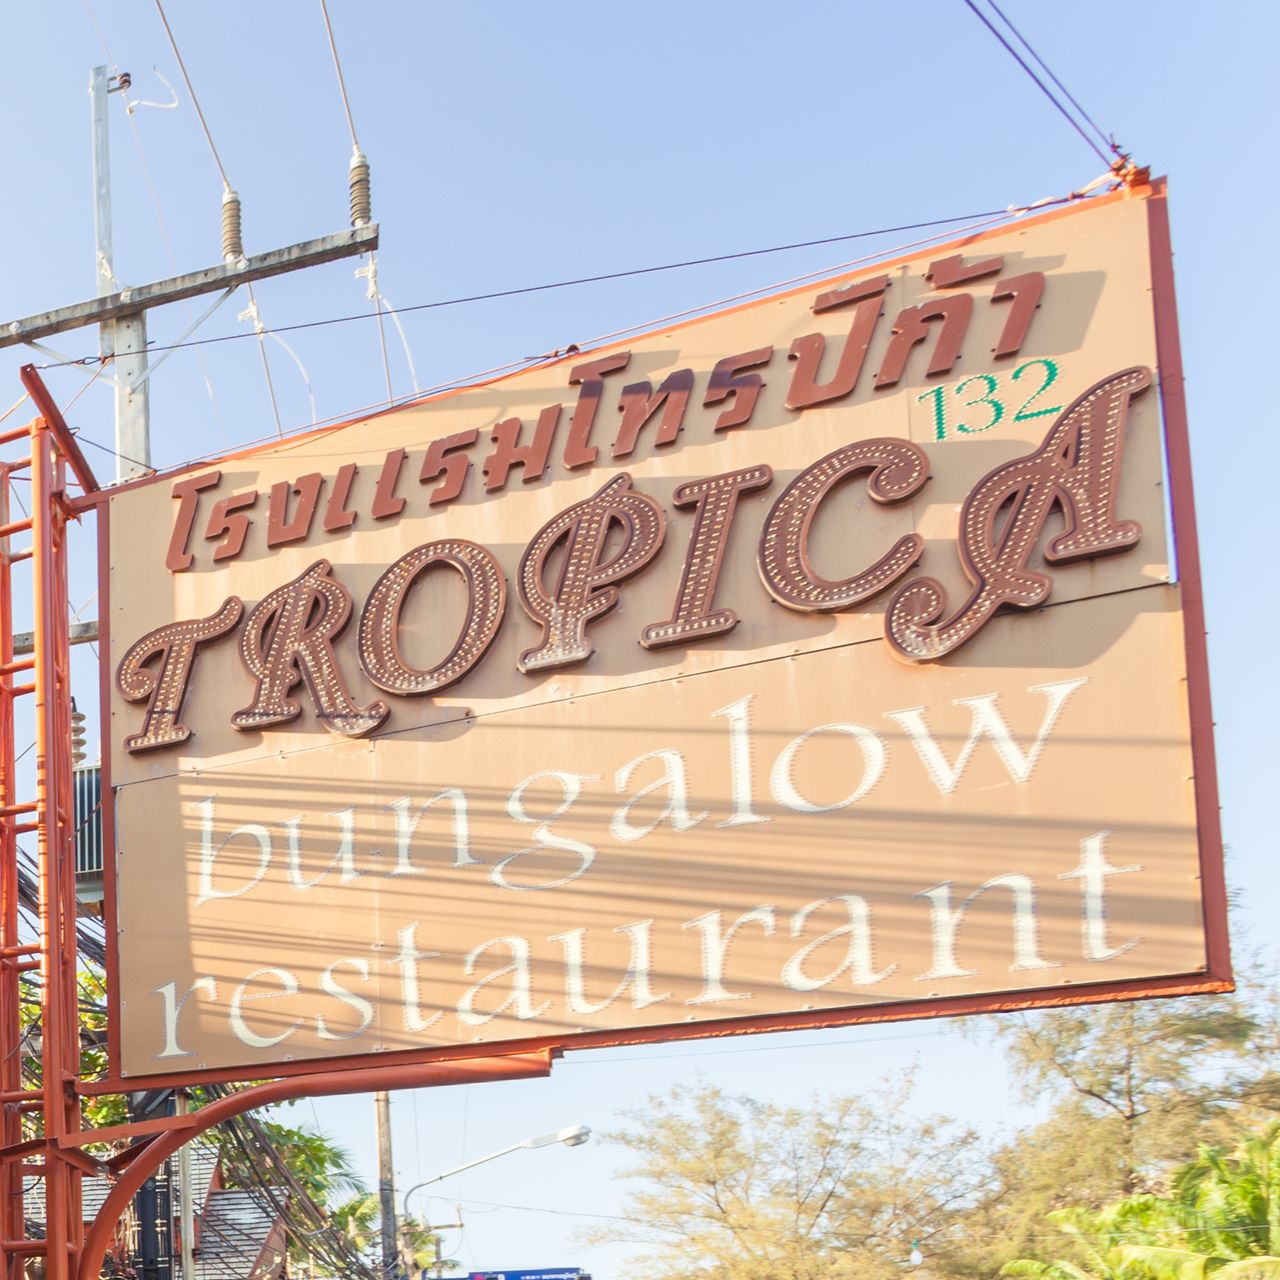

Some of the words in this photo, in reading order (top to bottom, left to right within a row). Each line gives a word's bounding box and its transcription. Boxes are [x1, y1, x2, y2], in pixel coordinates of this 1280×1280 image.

[915, 358, 1066, 442] 132
[115, 366, 1152, 755] TROPICA
[190, 677, 1091, 907] bungalow
[154, 831, 1144, 1060] restaurant
